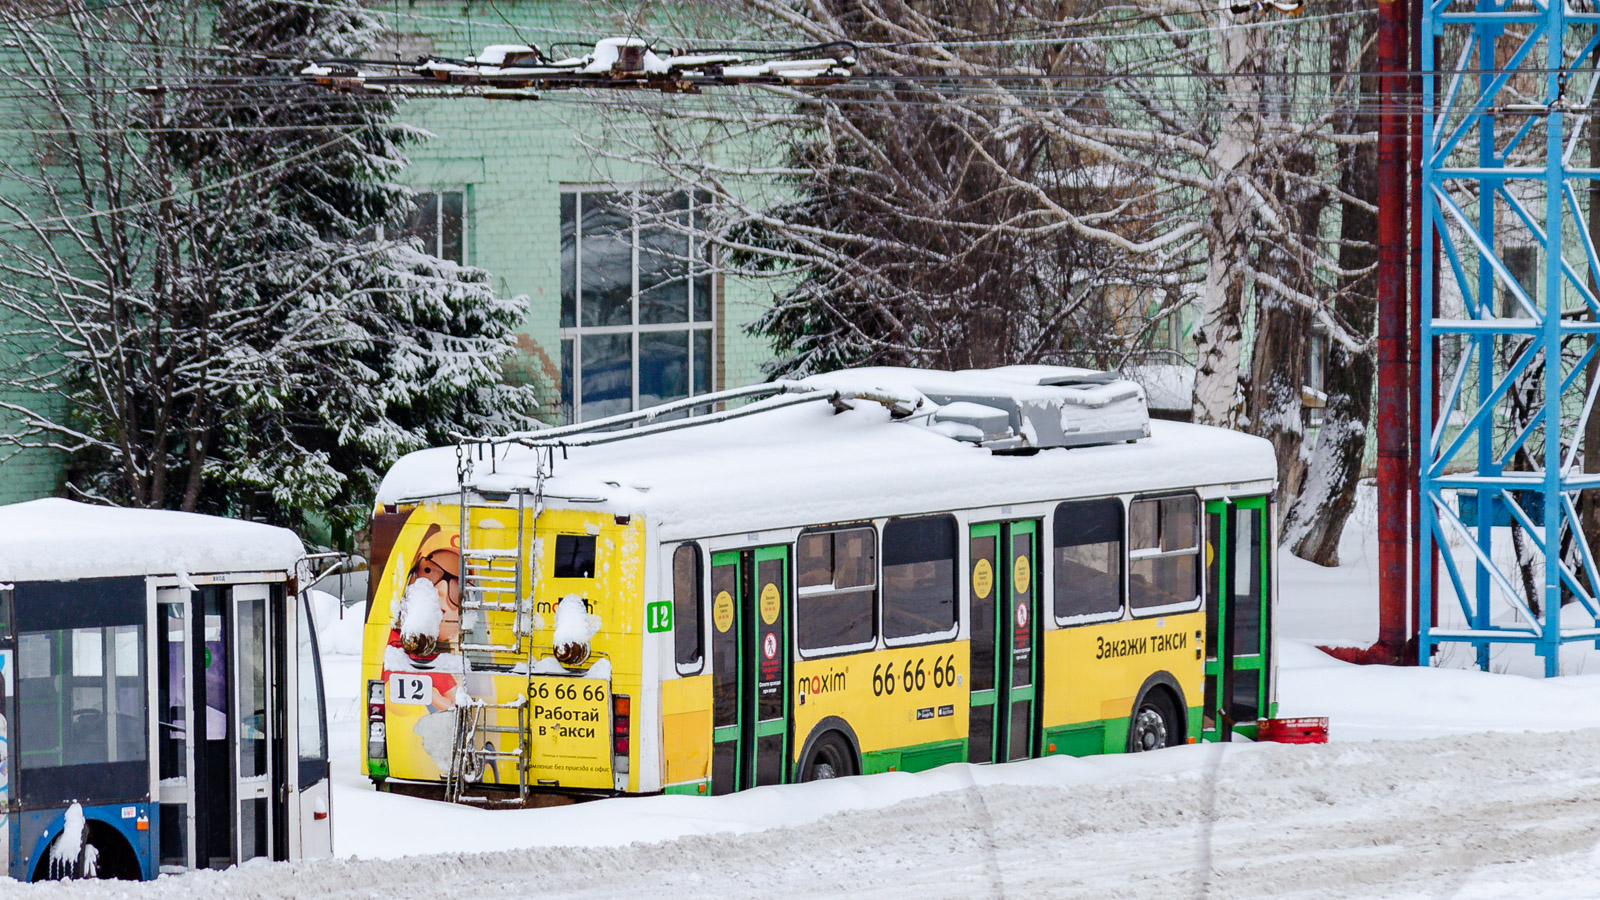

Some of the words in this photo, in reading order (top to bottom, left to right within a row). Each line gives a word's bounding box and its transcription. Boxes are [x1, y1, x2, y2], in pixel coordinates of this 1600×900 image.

[652, 605, 669, 629] 12
[1096, 636, 1147, 660] Закажи
[1150, 632, 1187, 653] такси
[398, 678, 424, 700] 12
[527, 682, 549, 699] 66
[555, 683, 577, 700] 66
[583, 685, 605, 701] 66
[798, 667, 846, 696] maxim
[534, 705, 599, 722] Работай
[539, 726, 547, 736] в
